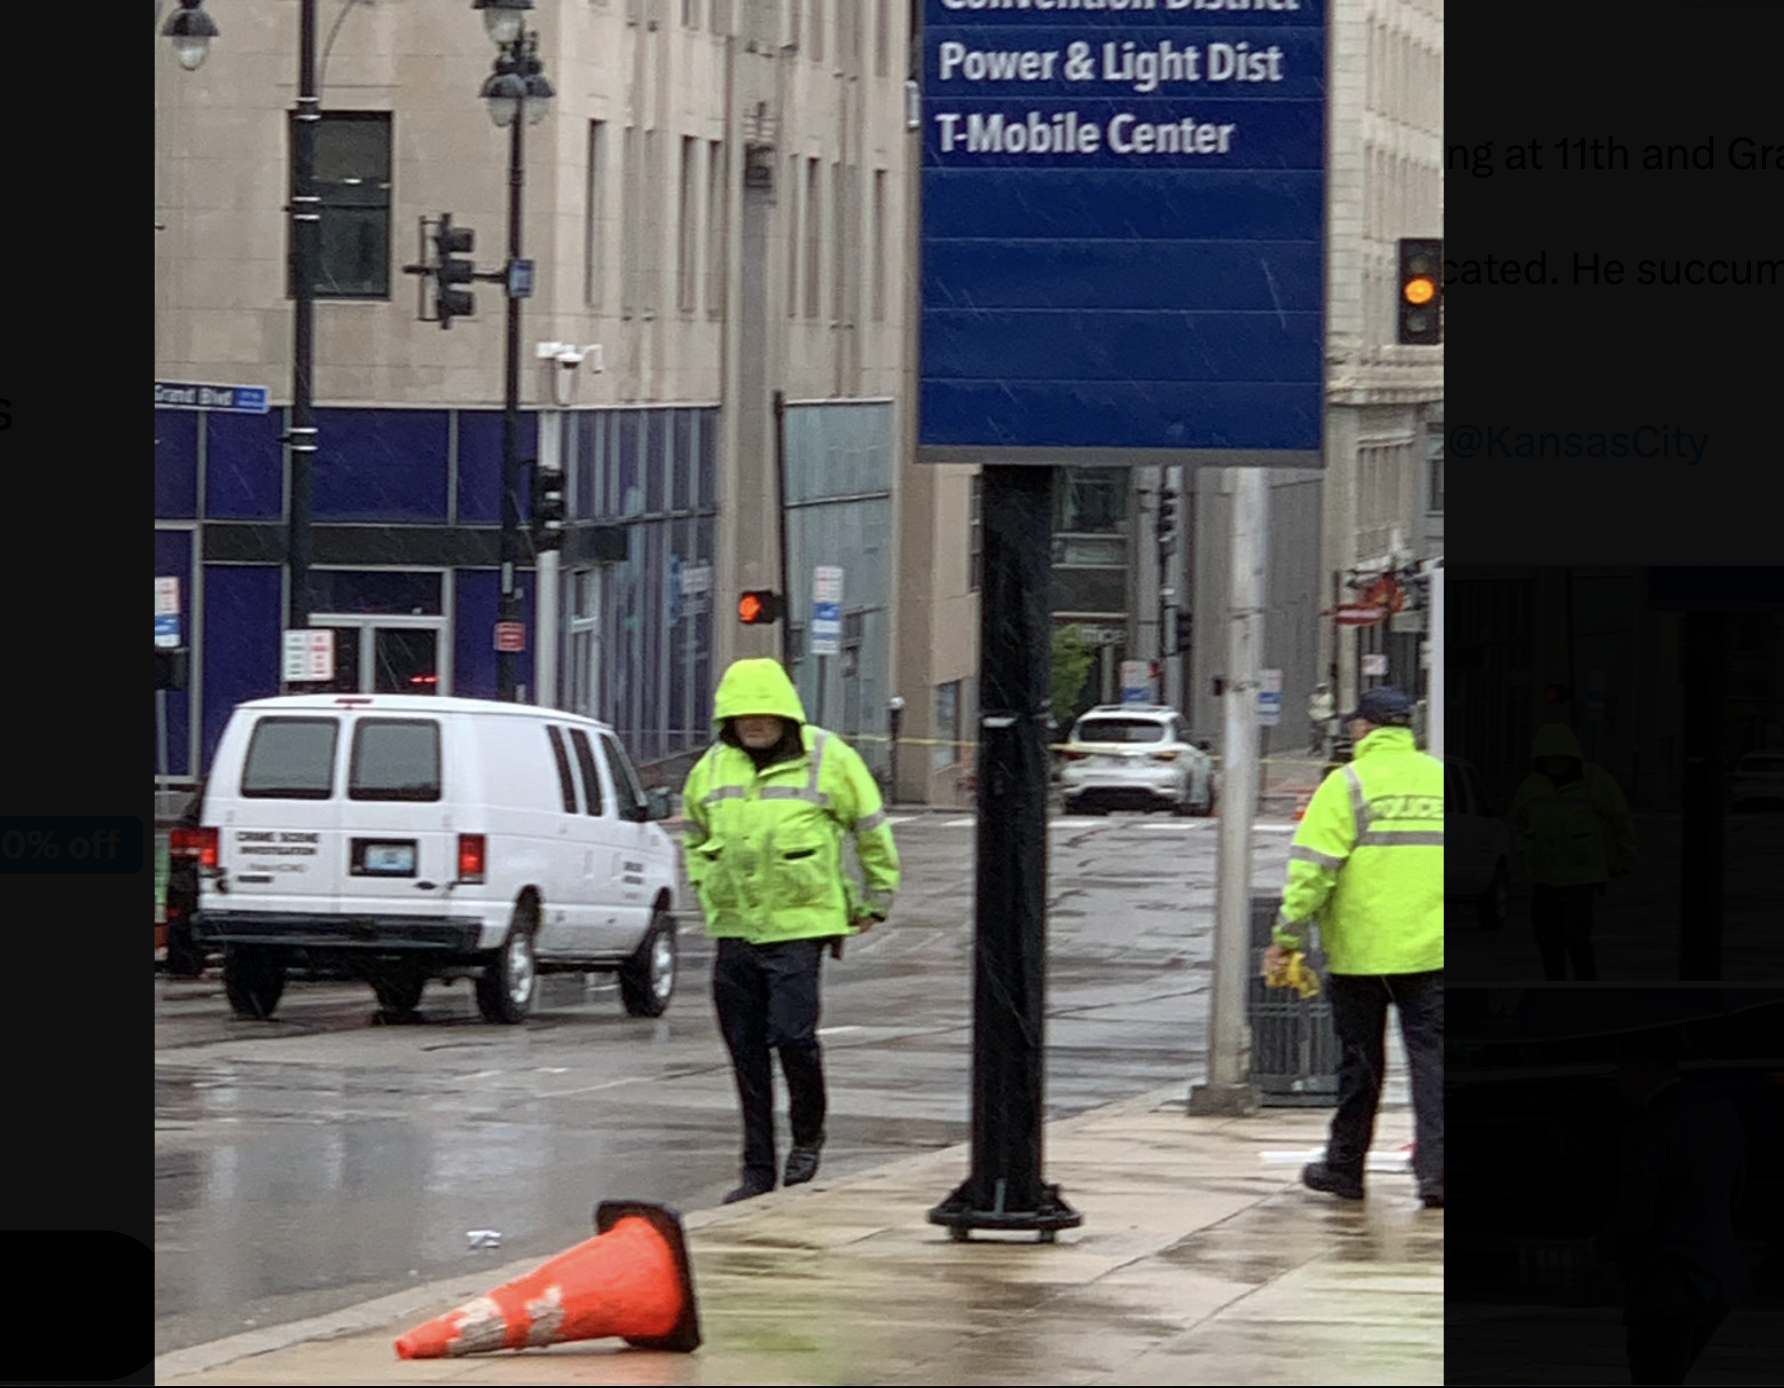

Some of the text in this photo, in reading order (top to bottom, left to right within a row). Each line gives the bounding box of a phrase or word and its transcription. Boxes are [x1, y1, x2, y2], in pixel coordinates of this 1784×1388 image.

[939, 40, 1284, 92] Power & Light Dist
[935, 111, 1236, 154] T-Mobile Center
